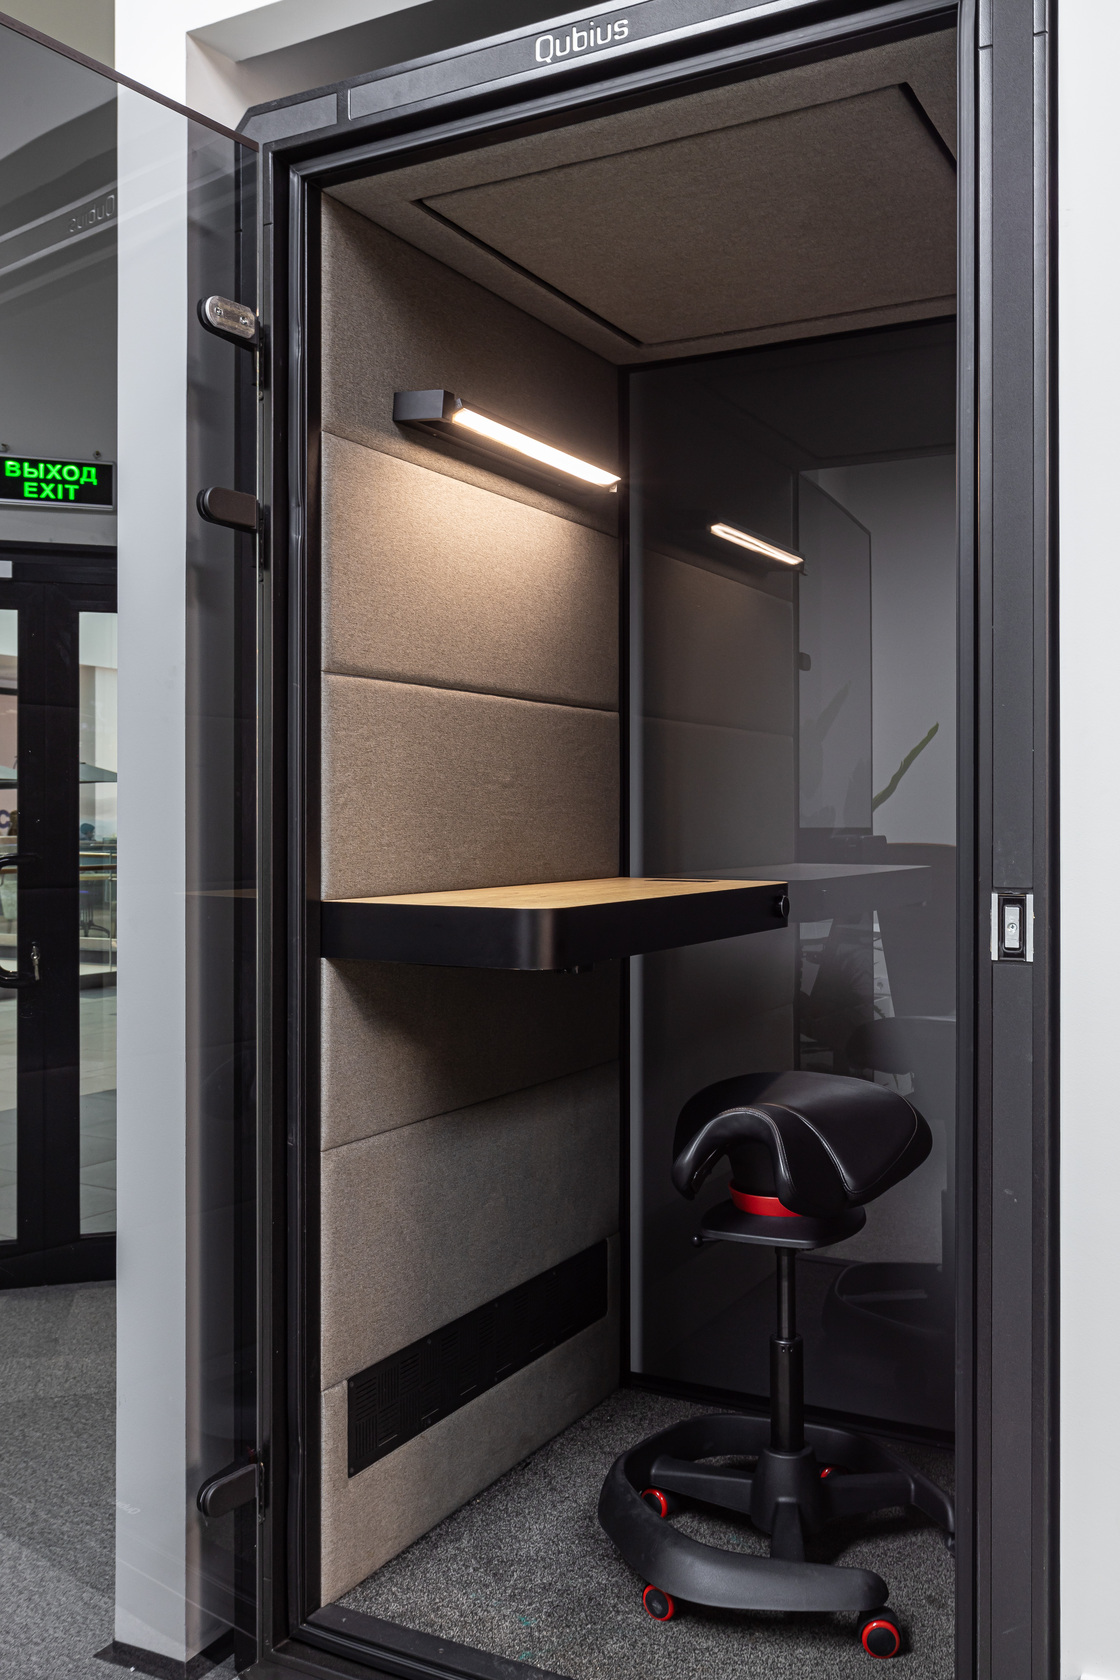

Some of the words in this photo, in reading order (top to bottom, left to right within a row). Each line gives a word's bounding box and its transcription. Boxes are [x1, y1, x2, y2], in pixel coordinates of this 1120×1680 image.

[535, 19, 629, 63] Qubius
[4, 460, 98, 486] ВЫХОД
[23, 481, 80, 500] EXIT
